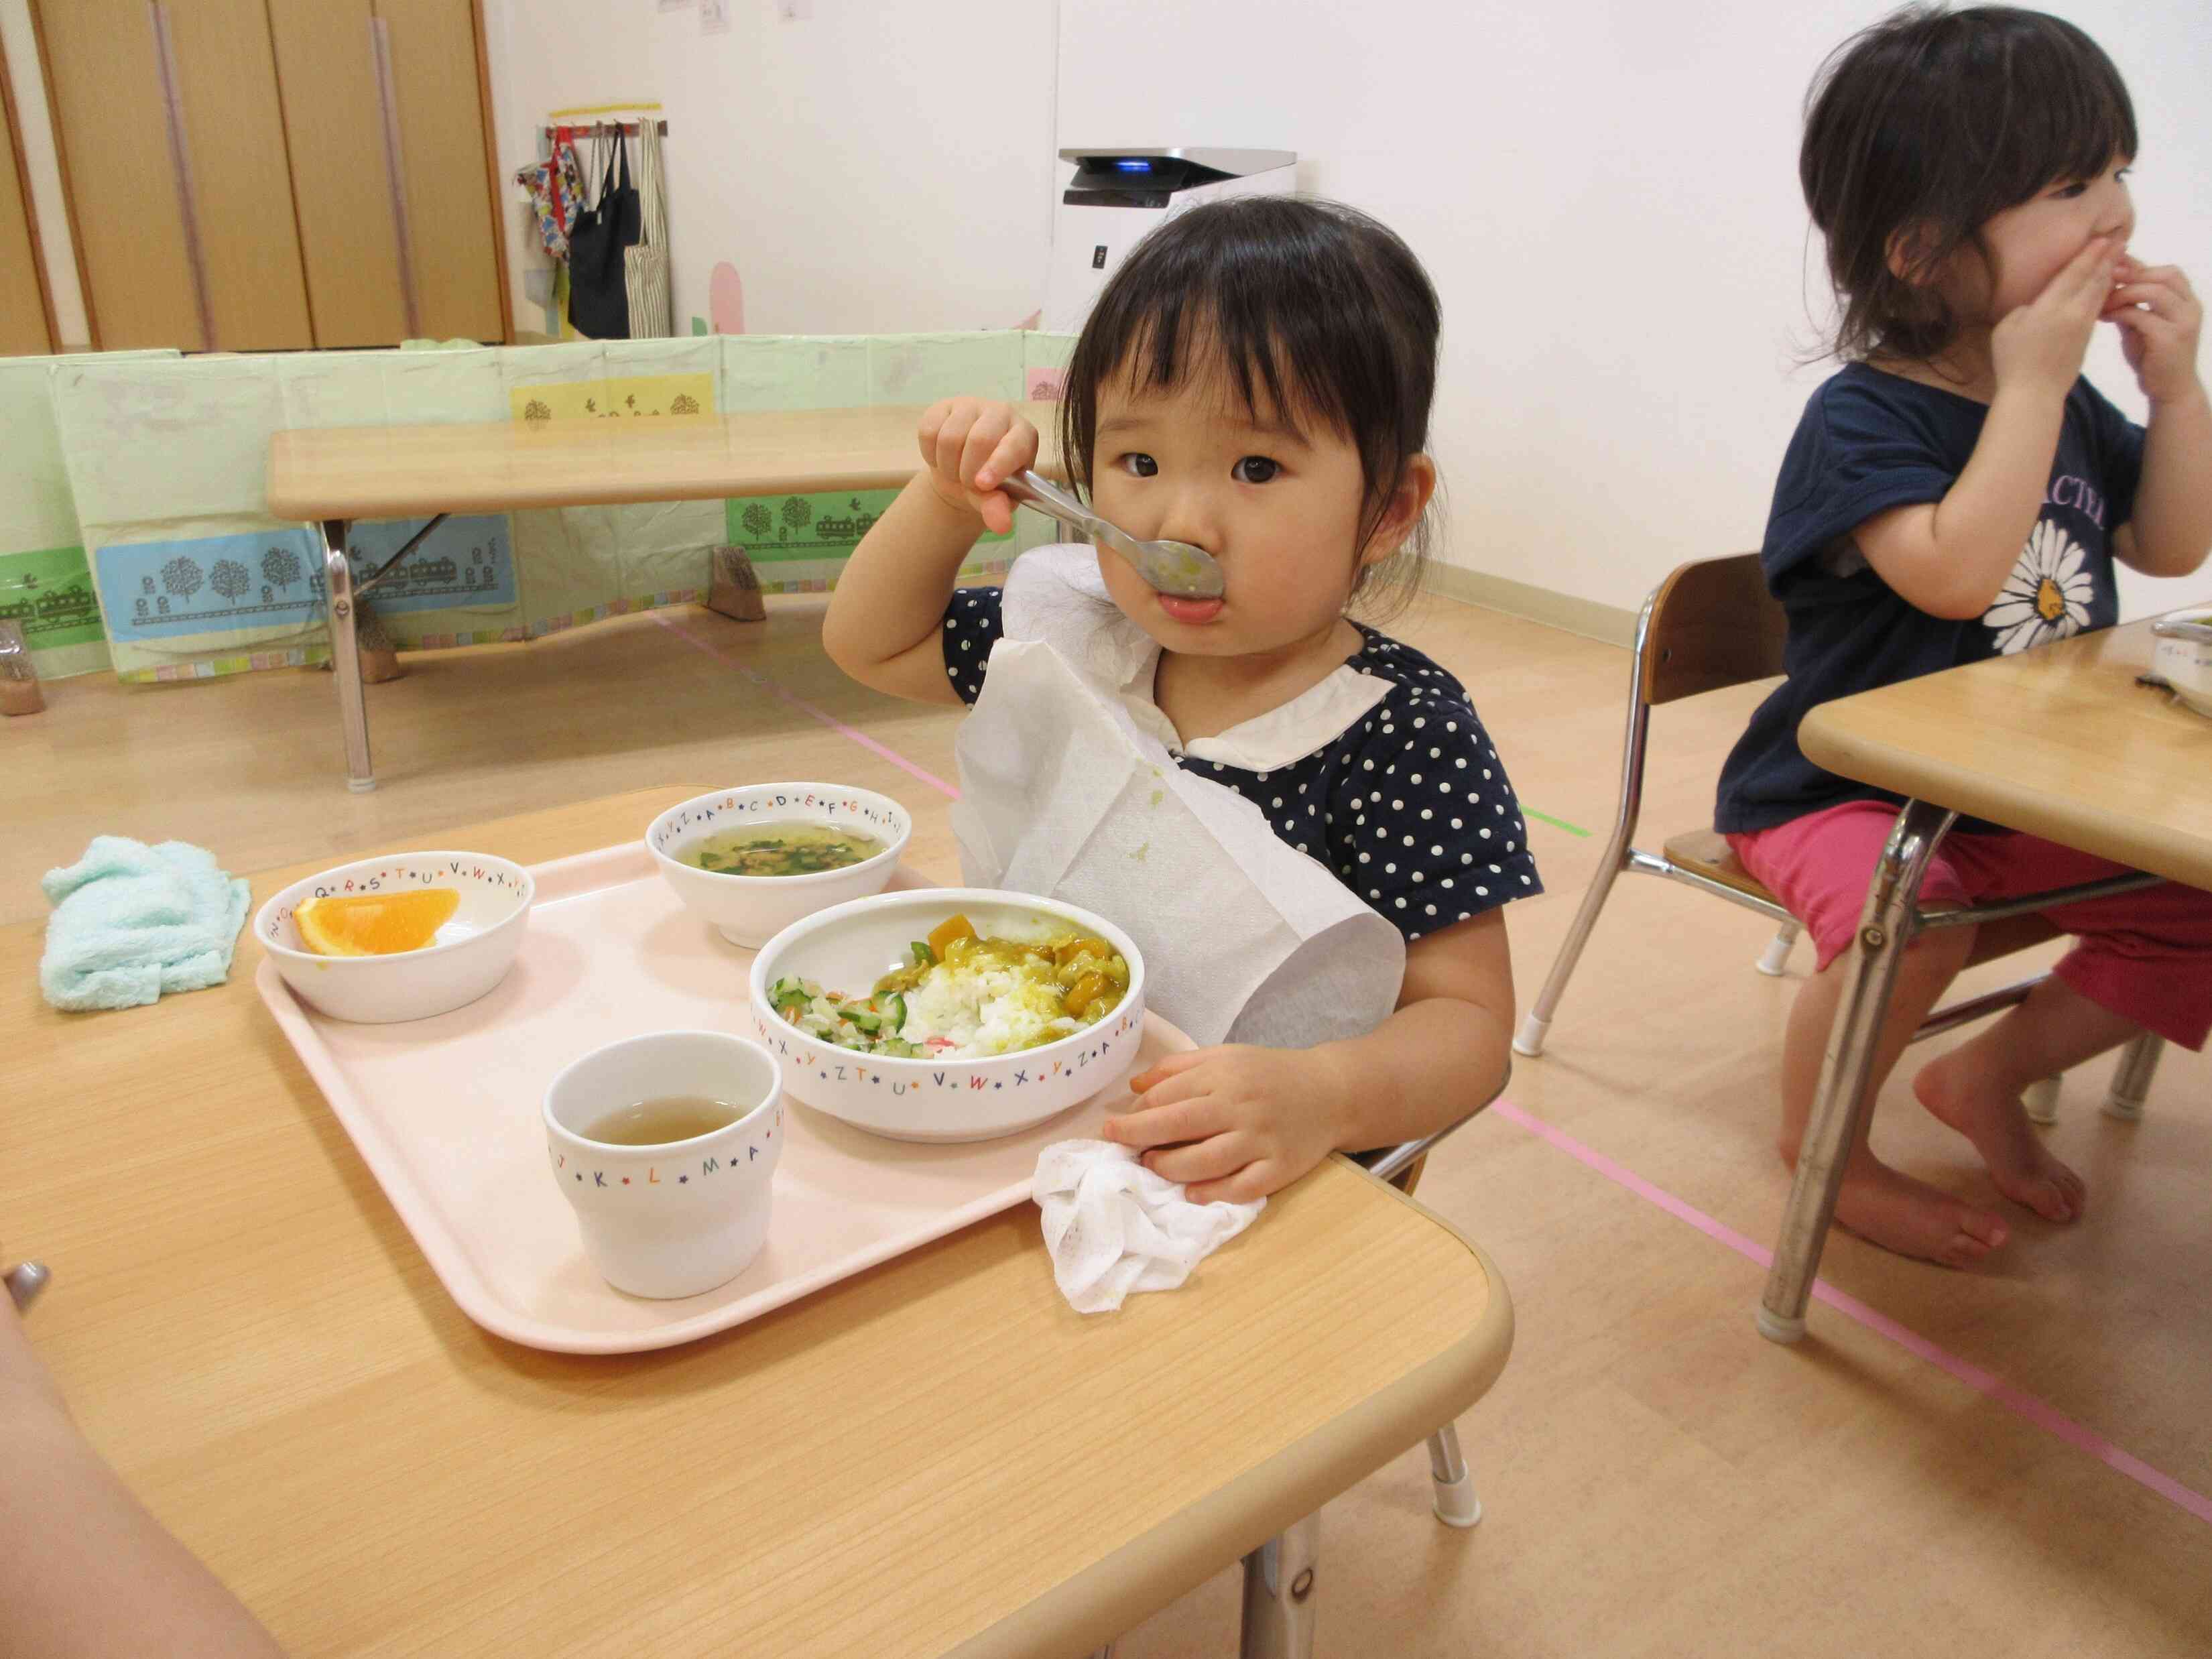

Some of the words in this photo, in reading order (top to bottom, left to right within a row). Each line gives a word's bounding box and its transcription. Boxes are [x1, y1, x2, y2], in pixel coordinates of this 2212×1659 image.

[706, 809, 715, 820] A
[727, 798, 735, 809] B
[750, 800, 758, 811] C
[776, 795, 787, 806] D
[804, 794, 816, 807] E
[828, 802, 836, 814] F
[849, 800, 858, 812] G
[869, 810, 879, 824] H
[315, 887, 330, 898] Q
[344, 879, 355, 892] R
[369, 877, 381, 890] S
[395, 868, 405, 879] T
[422, 873, 432, 884] U
[450, 861, 459, 874] V
[473, 865, 485, 879] W
[497, 872, 505, 885] X
[778, 1040, 788, 1055] X
[807, 1051, 816, 1065] Y
[835, 1066, 847, 1081] Z
[855, 1066, 867, 1081] T
[893, 1081, 906, 1095] U
[933, 1072, 945, 1086] V
[970, 1074, 989, 1091] W
[1014, 1069, 1029, 1086] X
[1053, 1061, 1062, 1075] Y
[1078, 1050, 1089, 1067] Z
[1102, 1041, 1110, 1055] A
[593, 1171, 609, 1188] K
[650, 1166, 661, 1183] L
[702, 1156, 720, 1176] M
[749, 1146, 759, 1162] A
